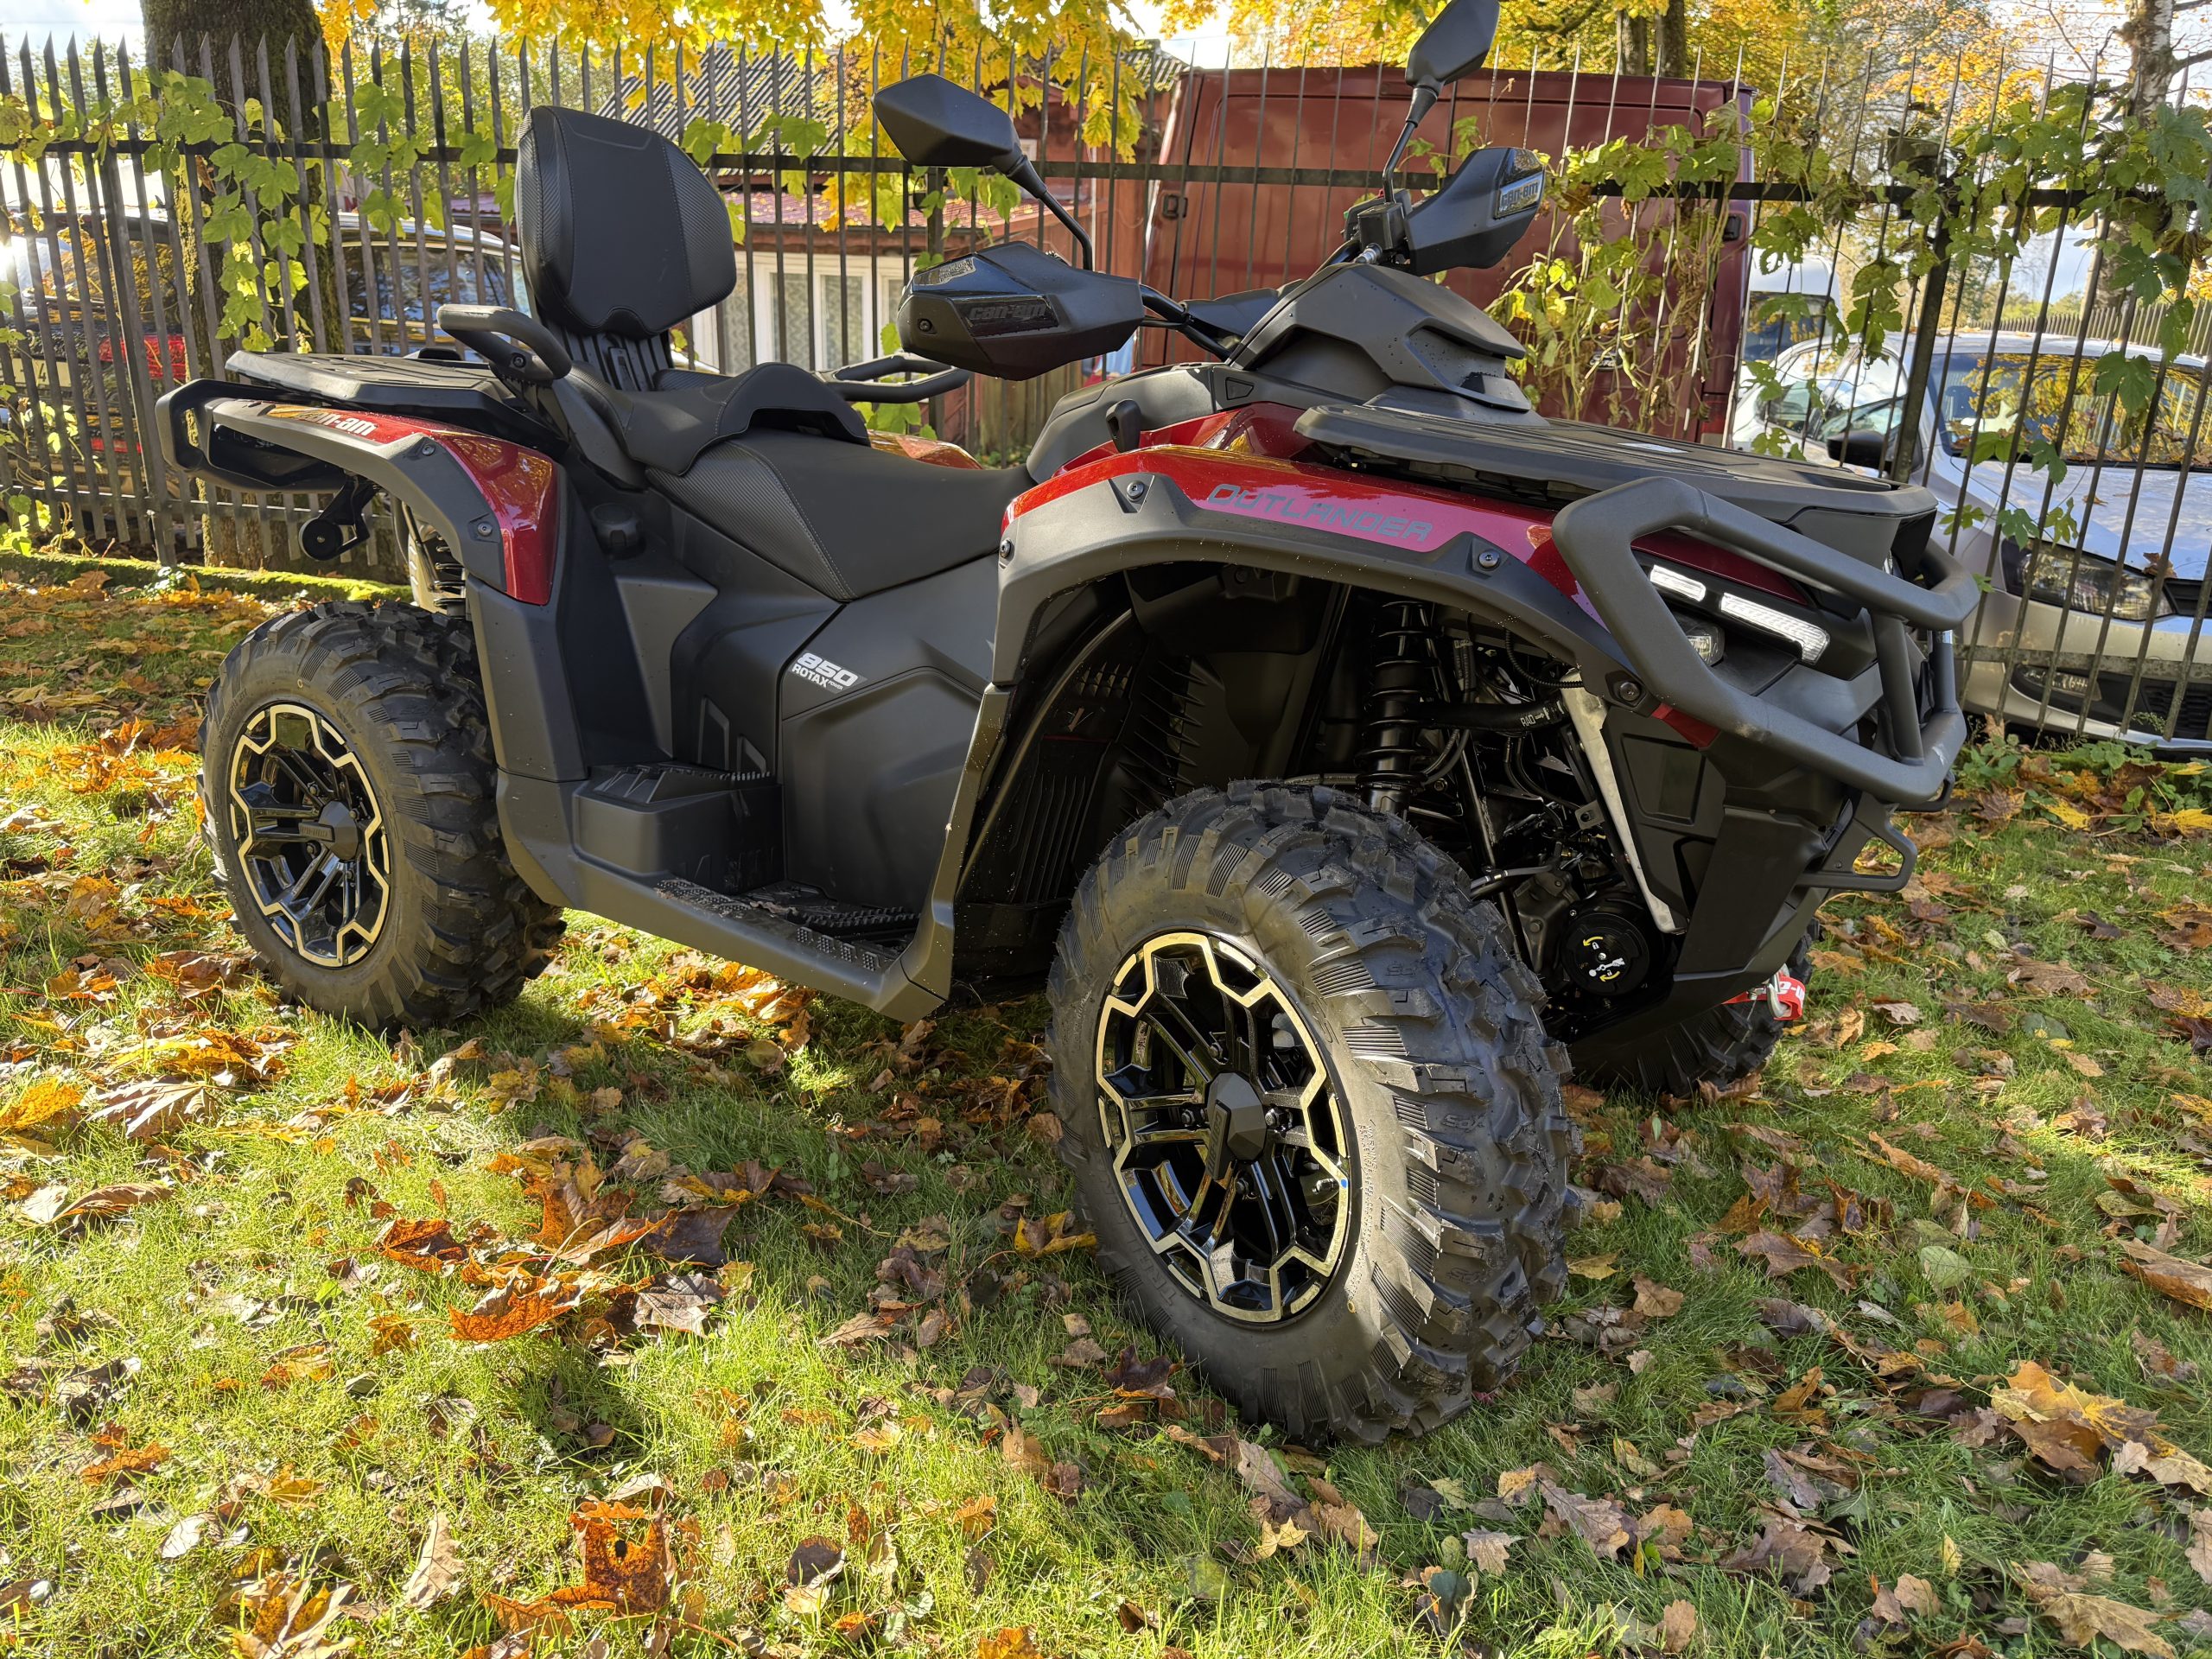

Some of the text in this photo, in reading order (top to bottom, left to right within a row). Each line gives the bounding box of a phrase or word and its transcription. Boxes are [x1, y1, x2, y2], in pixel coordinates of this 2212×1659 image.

[1500, 181, 1539, 207] can-am
[969, 302, 1046, 321] can-am
[1207, 483, 1433, 542] OUTLANDER
[791, 663, 843, 690] ROTAX POWER
[797, 652, 858, 687] 850
[1521, 714, 1536, 727] RAD
